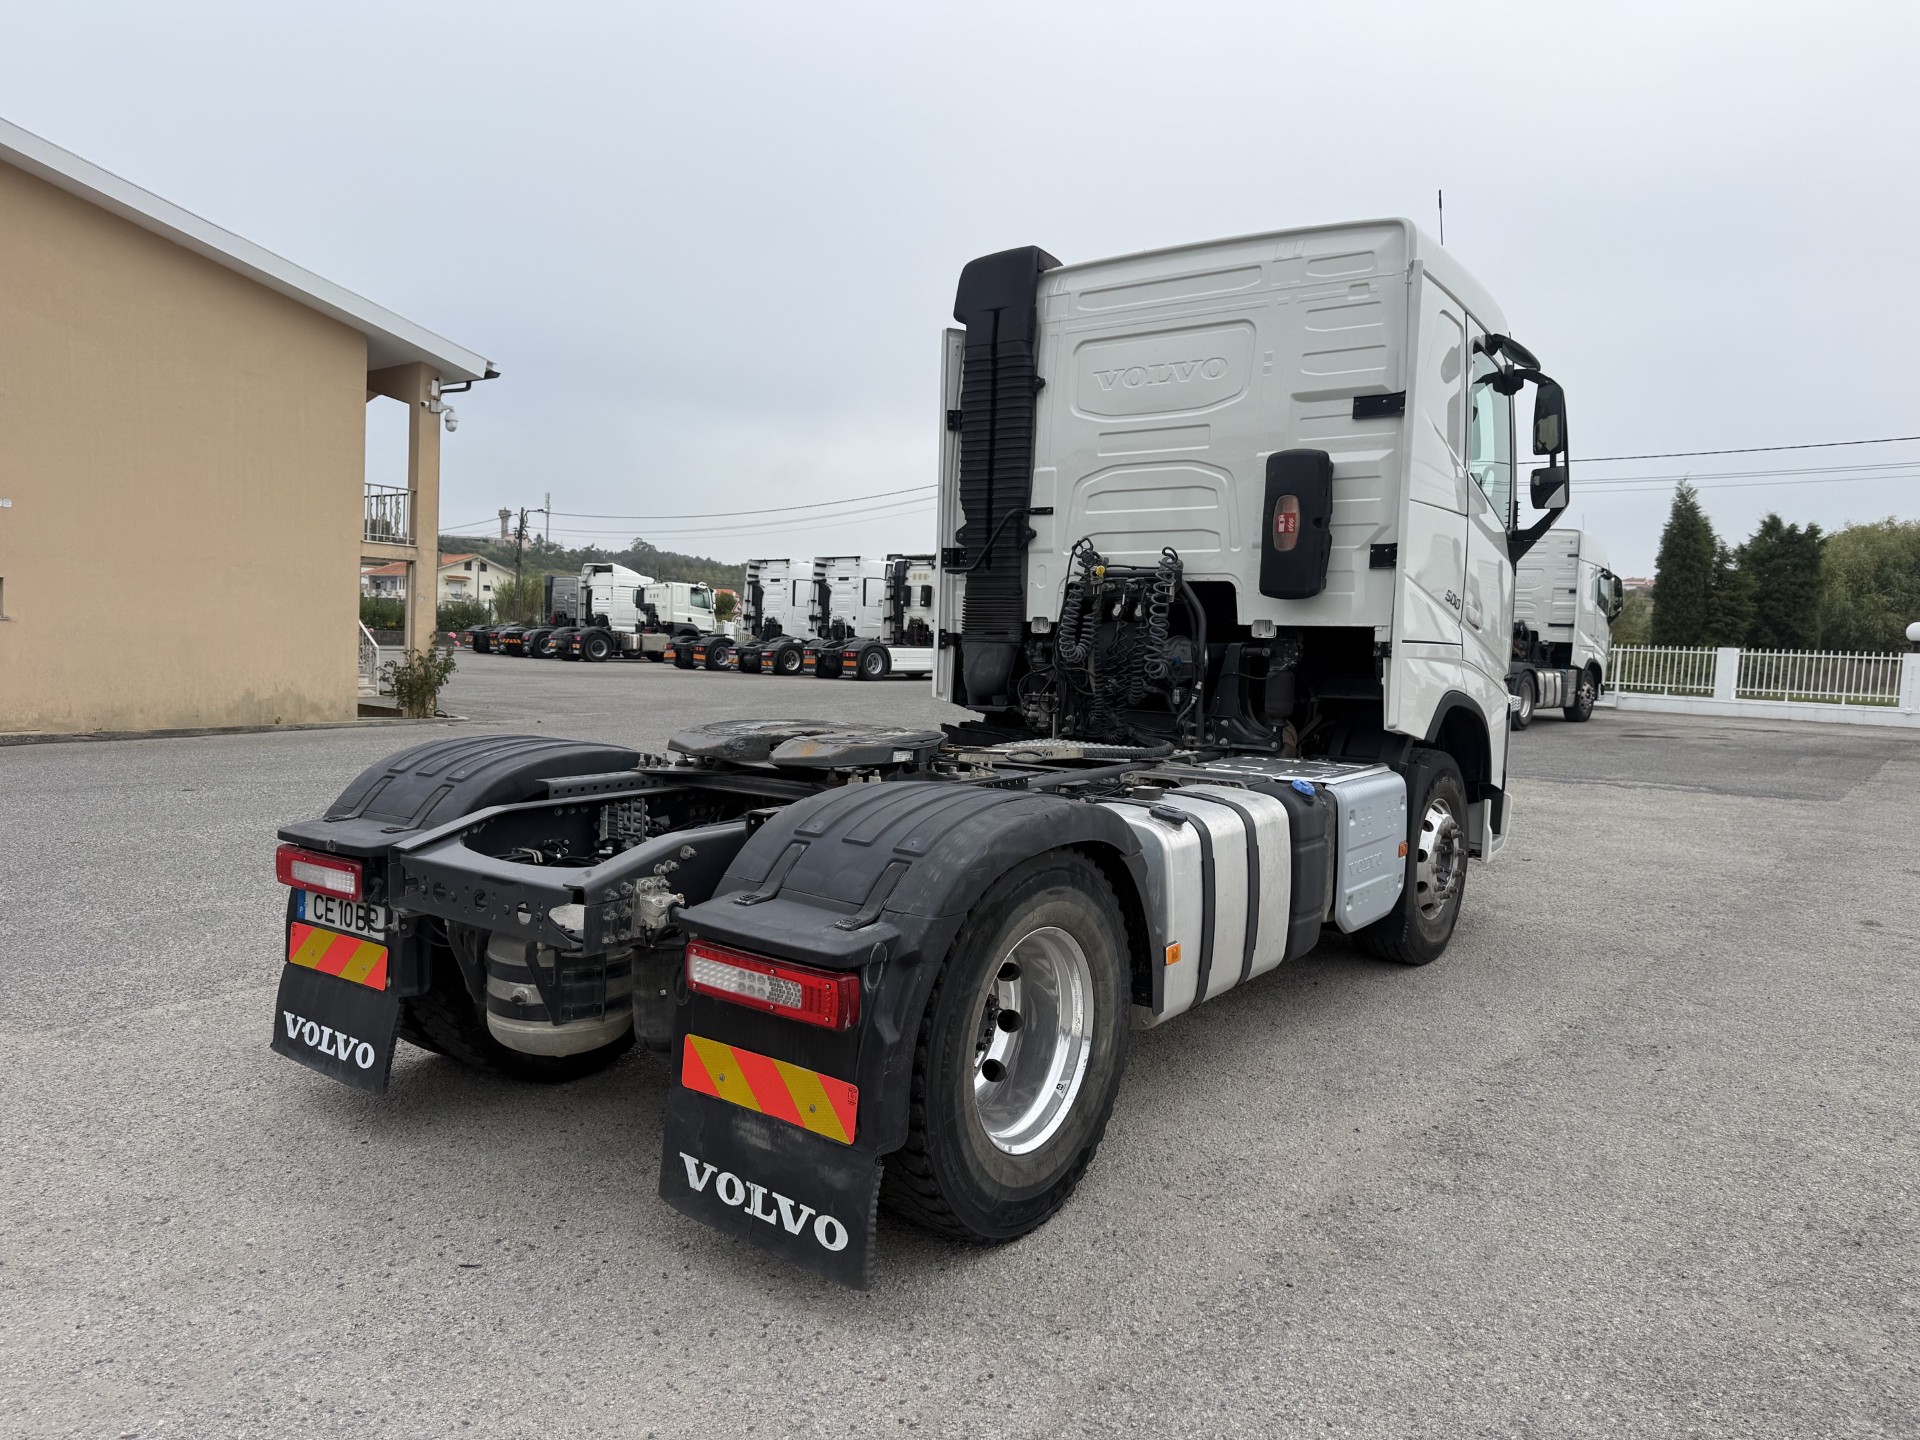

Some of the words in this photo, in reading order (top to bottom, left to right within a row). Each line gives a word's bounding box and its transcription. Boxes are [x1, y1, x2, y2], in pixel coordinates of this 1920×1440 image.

[1093, 357, 1228, 391] VOLVO
[1445, 590, 1461, 610] 500
[283, 1010, 375, 1069] VOLVO
[679, 1151, 849, 1251] VOLVO
